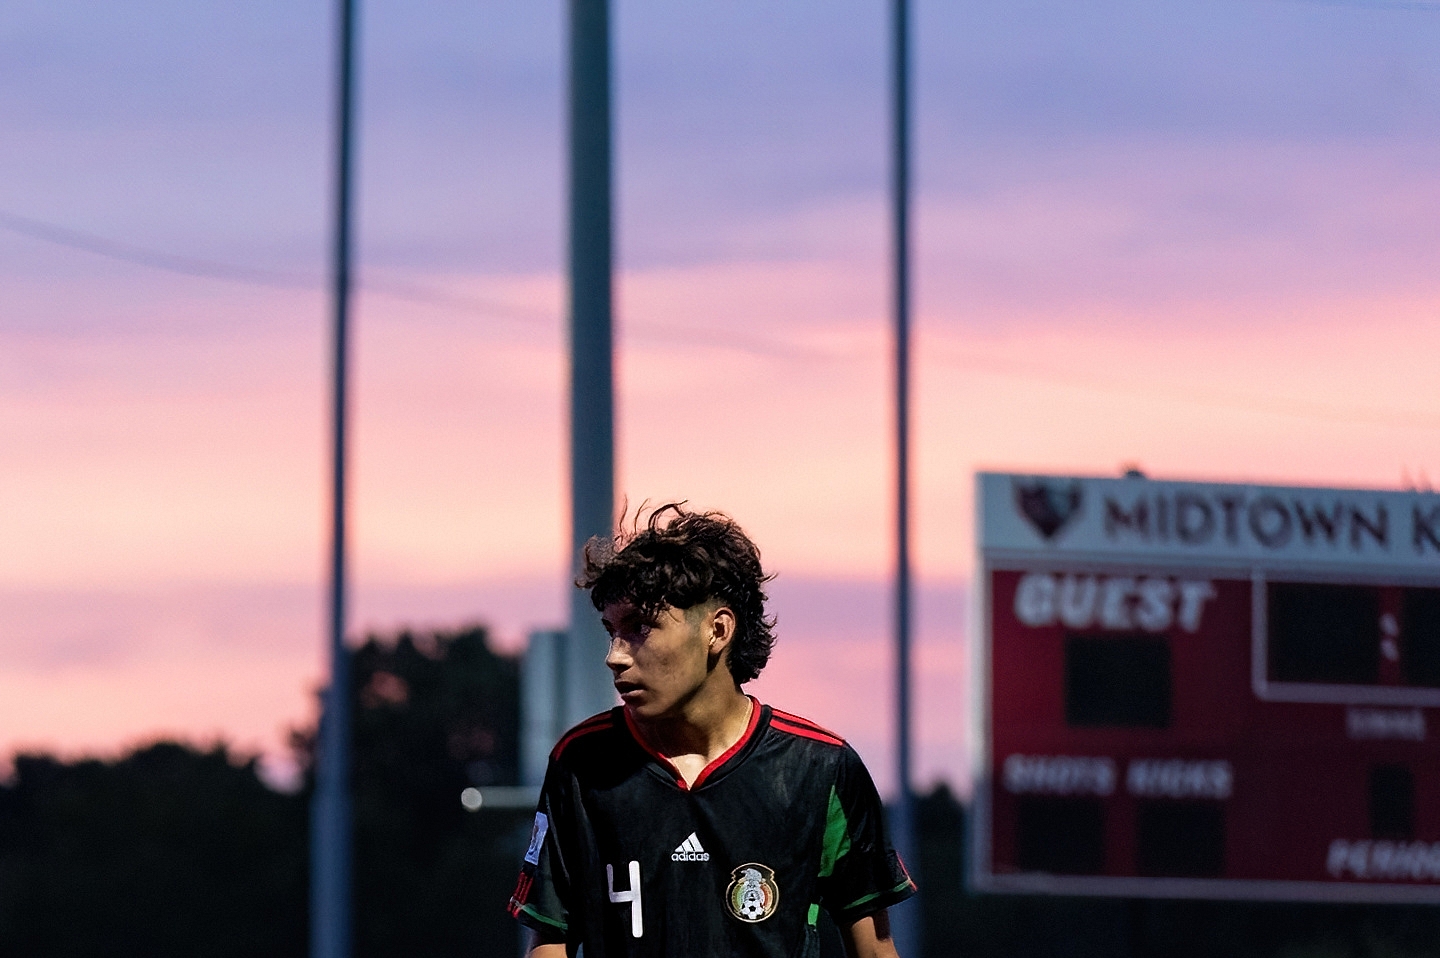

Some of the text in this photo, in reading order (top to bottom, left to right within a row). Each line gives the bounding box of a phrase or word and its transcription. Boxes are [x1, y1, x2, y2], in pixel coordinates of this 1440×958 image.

[1103, 491, 1390, 549] MIDTOWN
[1015, 573, 1214, 632] GUEST
[1126, 758, 1233, 799] KICKS
[671, 851, 710, 862] adidas
[606, 860, 644, 938] 4
